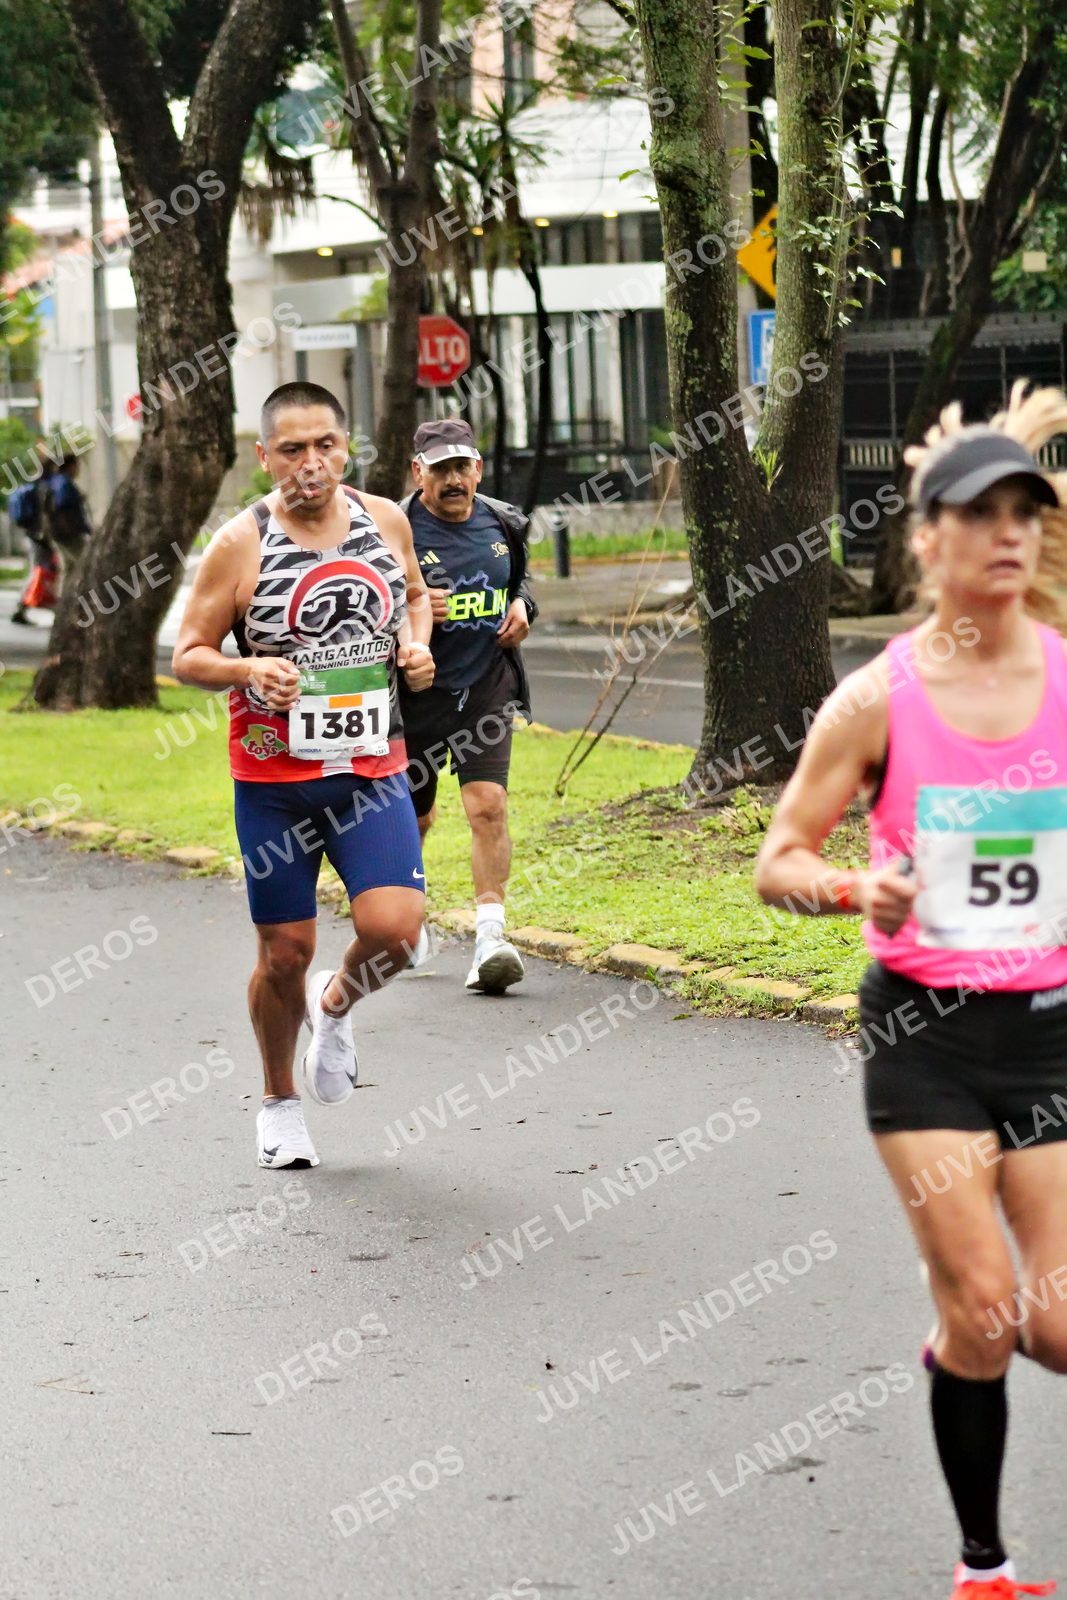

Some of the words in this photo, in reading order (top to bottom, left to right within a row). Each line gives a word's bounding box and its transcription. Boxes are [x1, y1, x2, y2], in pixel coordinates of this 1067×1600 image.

[287, 640, 390, 666] MARGARITOS
[308, 660, 350, 671] RUNNING
[352, 655, 375, 664] TEAM
[300, 707, 379, 739] 1381
[247, 740, 278, 757] toys
[968, 862, 1040, 907] 59
